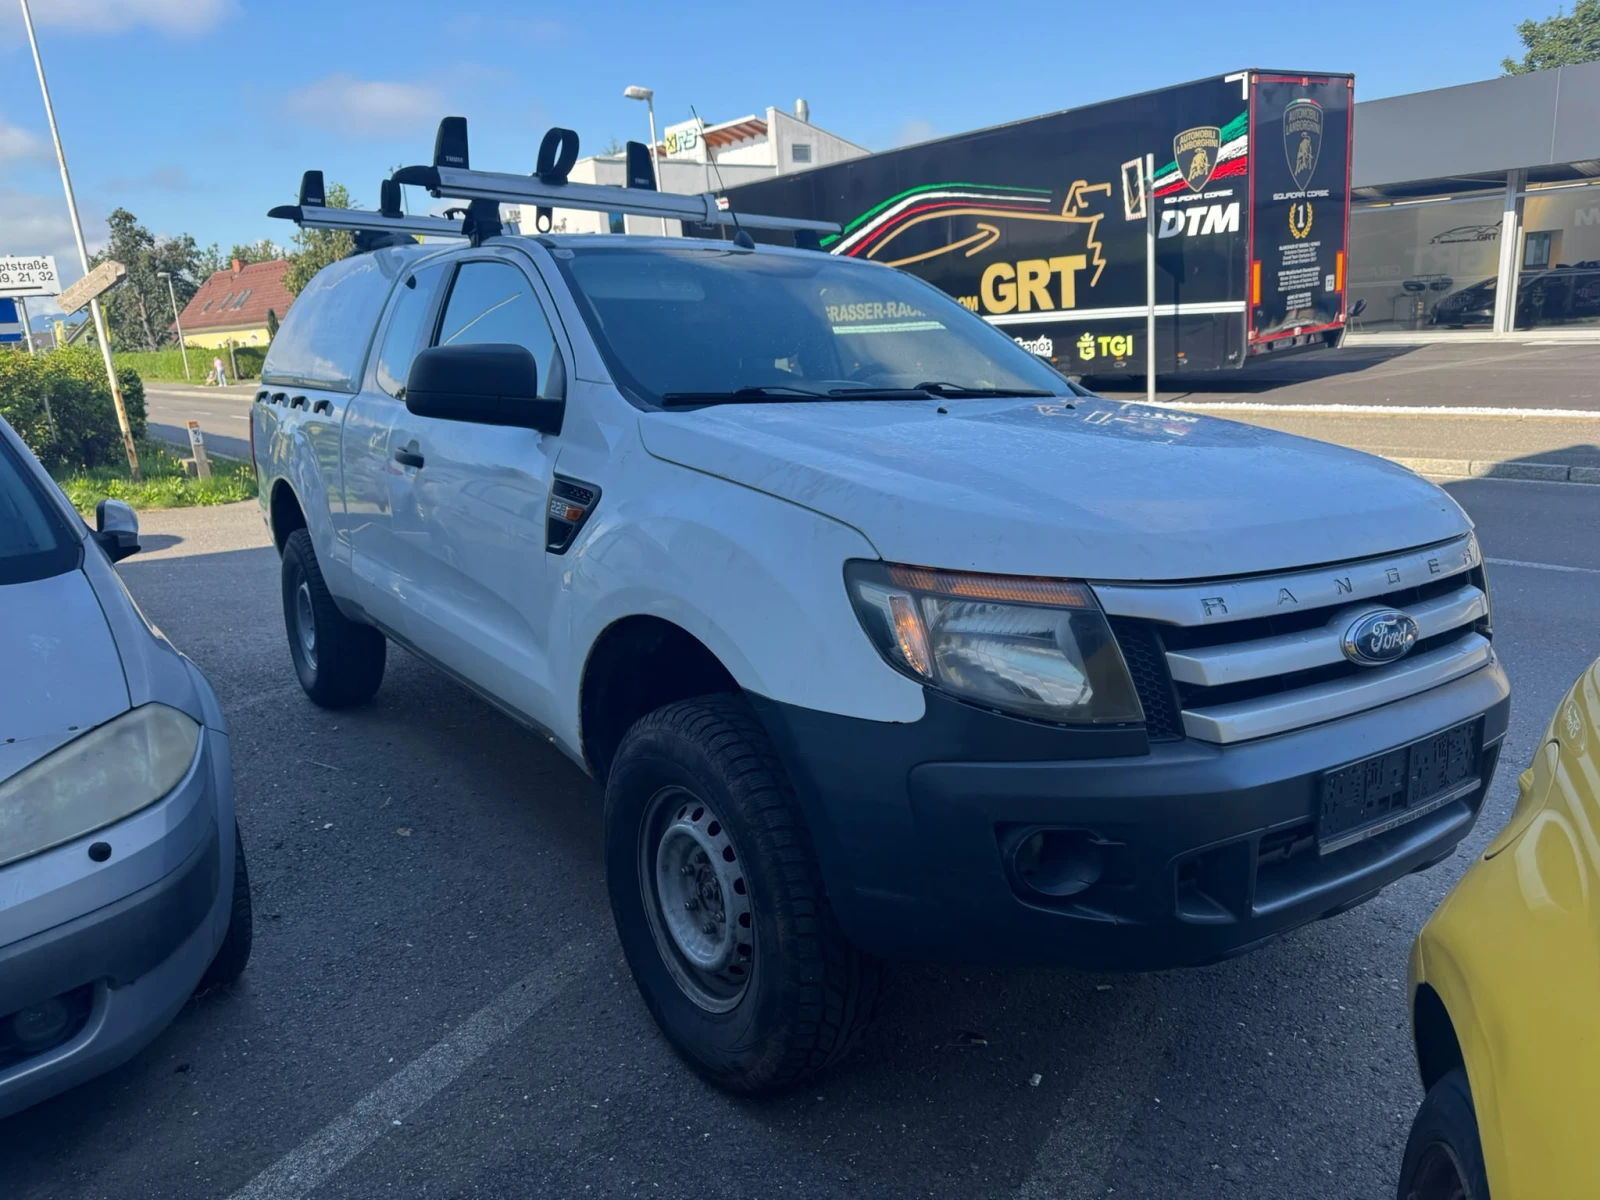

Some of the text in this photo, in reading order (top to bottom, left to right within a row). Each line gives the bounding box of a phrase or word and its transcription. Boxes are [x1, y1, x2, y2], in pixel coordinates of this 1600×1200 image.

[1289, 108, 1319, 122] AUTOMOBILI
[1179, 129, 1216, 145] AUTOMOBILI
[1286, 119, 1320, 136] LAMBORGHINI
[1177, 139, 1218, 154] LAMBORGHINI
[1158, 202, 1240, 239] DTM
[1297, 205, 1304, 228] 1
[1477, 233, 1498, 242] GRT
[18, 272, 35, 284] 21,
[38, 271, 54, 281] 32
[981, 254, 1087, 313] GRT
[1097, 335, 1133, 356] TGI
[1200, 549, 1474, 617] RANGER
[1371, 619, 1407, 653] Ford
